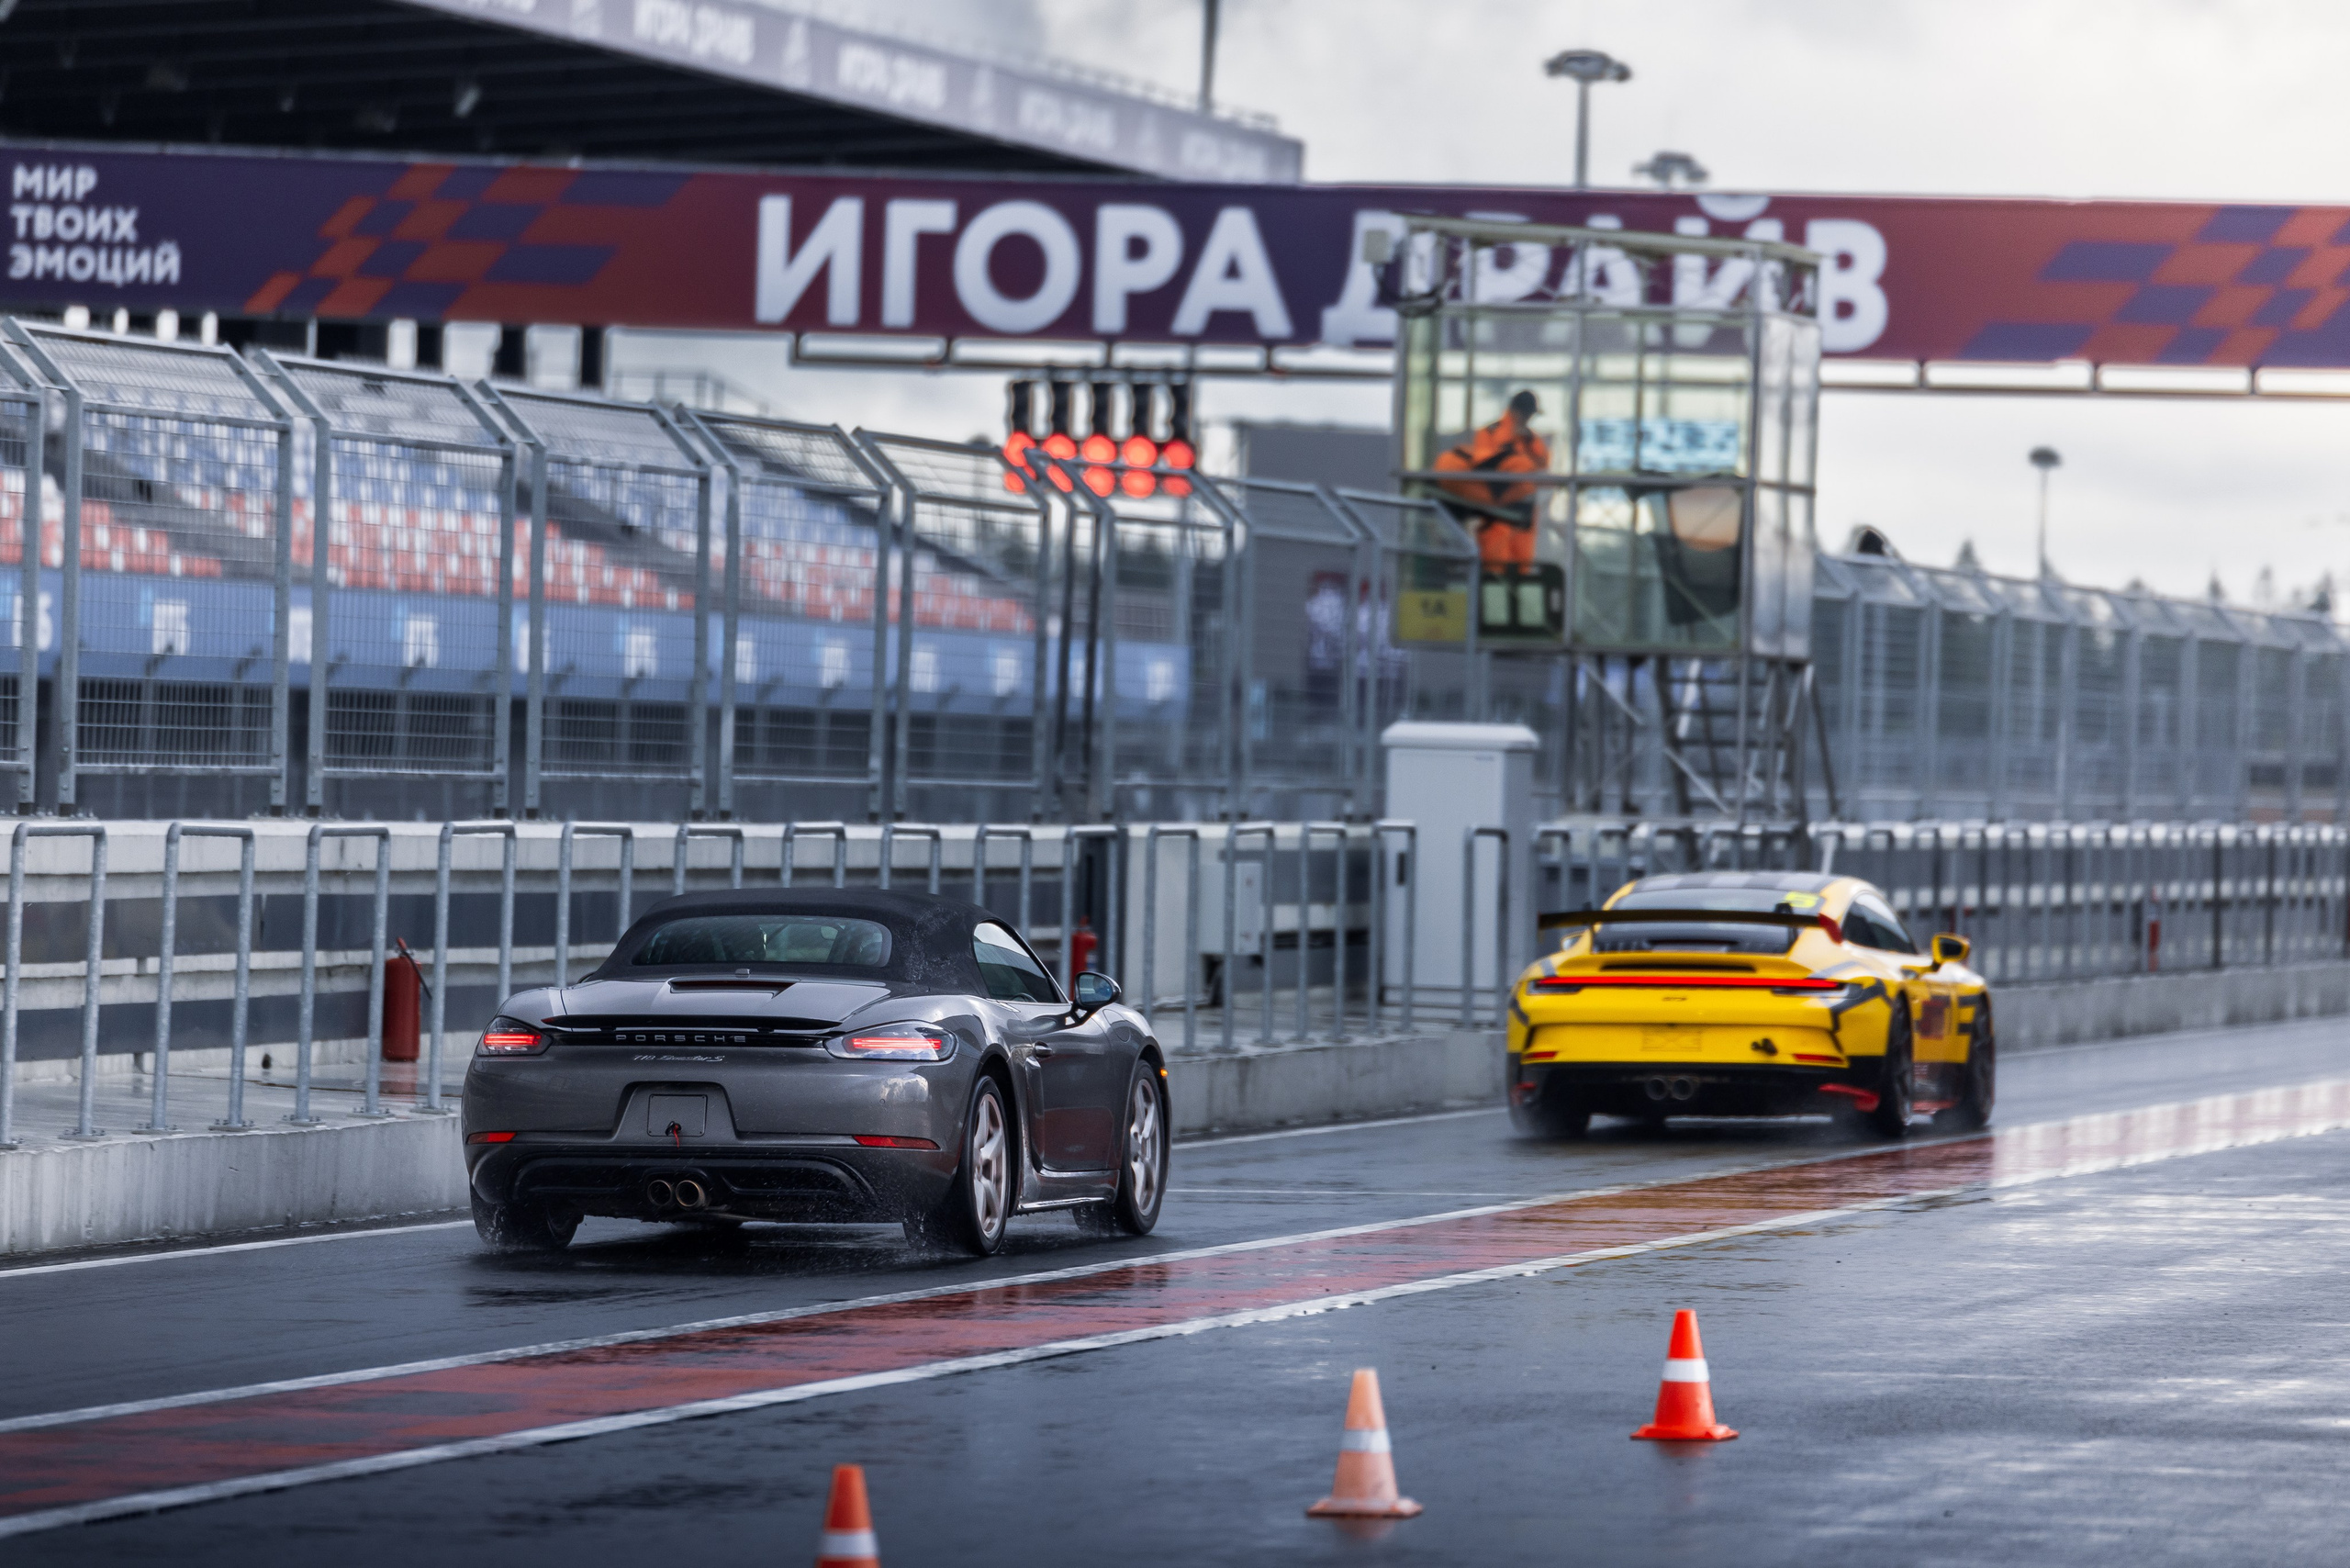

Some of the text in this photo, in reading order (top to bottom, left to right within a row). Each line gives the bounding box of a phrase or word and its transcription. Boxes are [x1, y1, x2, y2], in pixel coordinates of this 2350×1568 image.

[13, 163, 98, 202] МИР
[9, 204, 139, 243] ТВОИХ
[8, 241, 181, 289] ЭМОЦИЙ
[755, 194, 1294, 338] ИГОРА
[615, 1034, 746, 1043] PORSCHE
